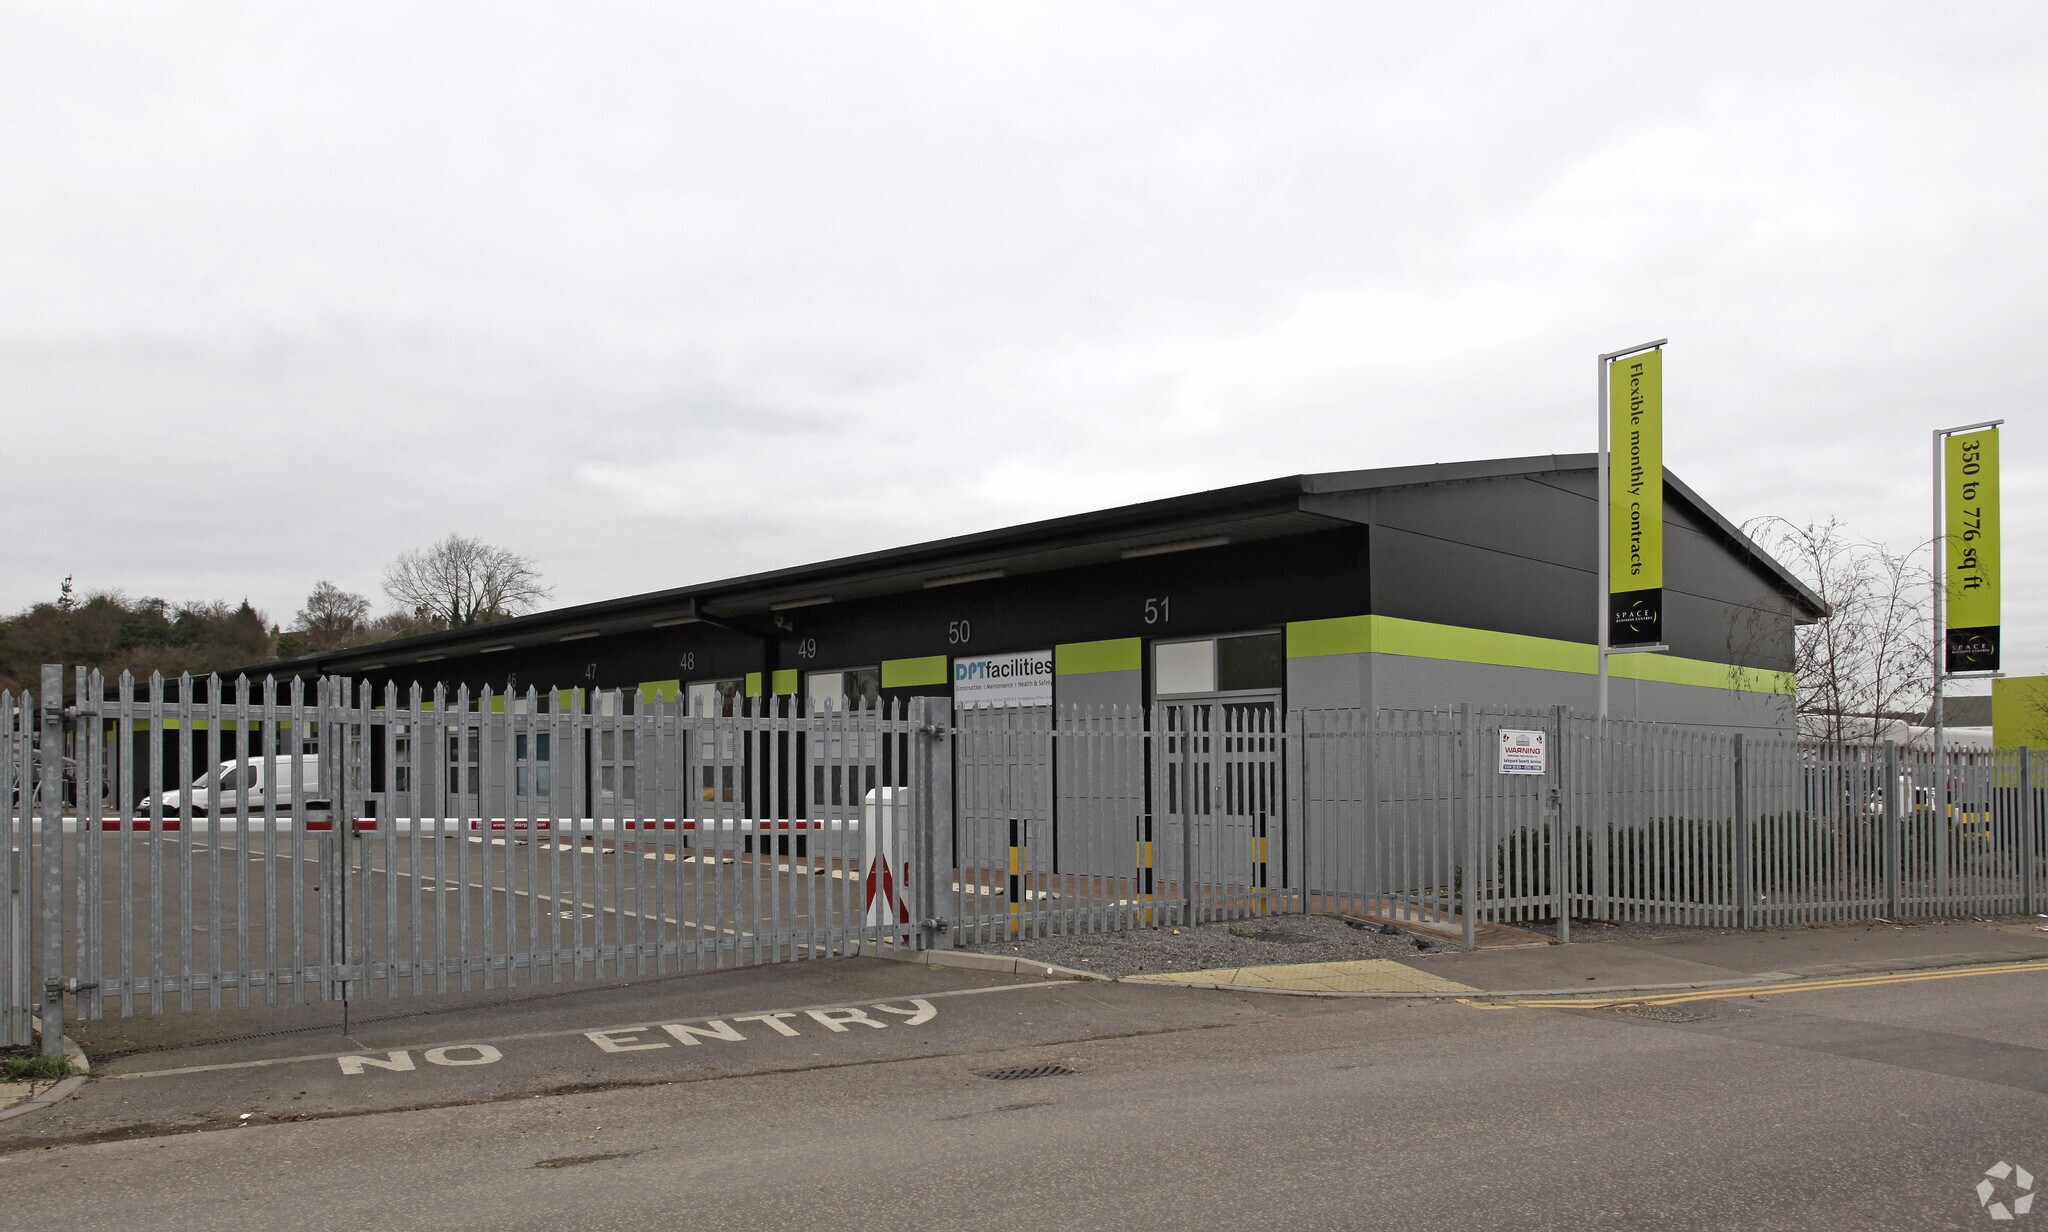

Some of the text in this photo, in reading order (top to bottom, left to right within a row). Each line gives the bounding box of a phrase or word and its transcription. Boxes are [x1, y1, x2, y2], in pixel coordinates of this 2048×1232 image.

[1627, 363, 1644, 576] Flexible monthly contracts
[1957, 440, 1983, 590] 350 to 776 sq ft
[1144, 596, 1169, 624] 51
[1616, 610, 1649, 619] SPACE
[949, 620, 971, 644] 50
[798, 638, 816, 659] 49
[585, 663, 597, 680] 47
[680, 652, 695, 671] 48
[337, 998, 937, 1076] NO ENTRY
